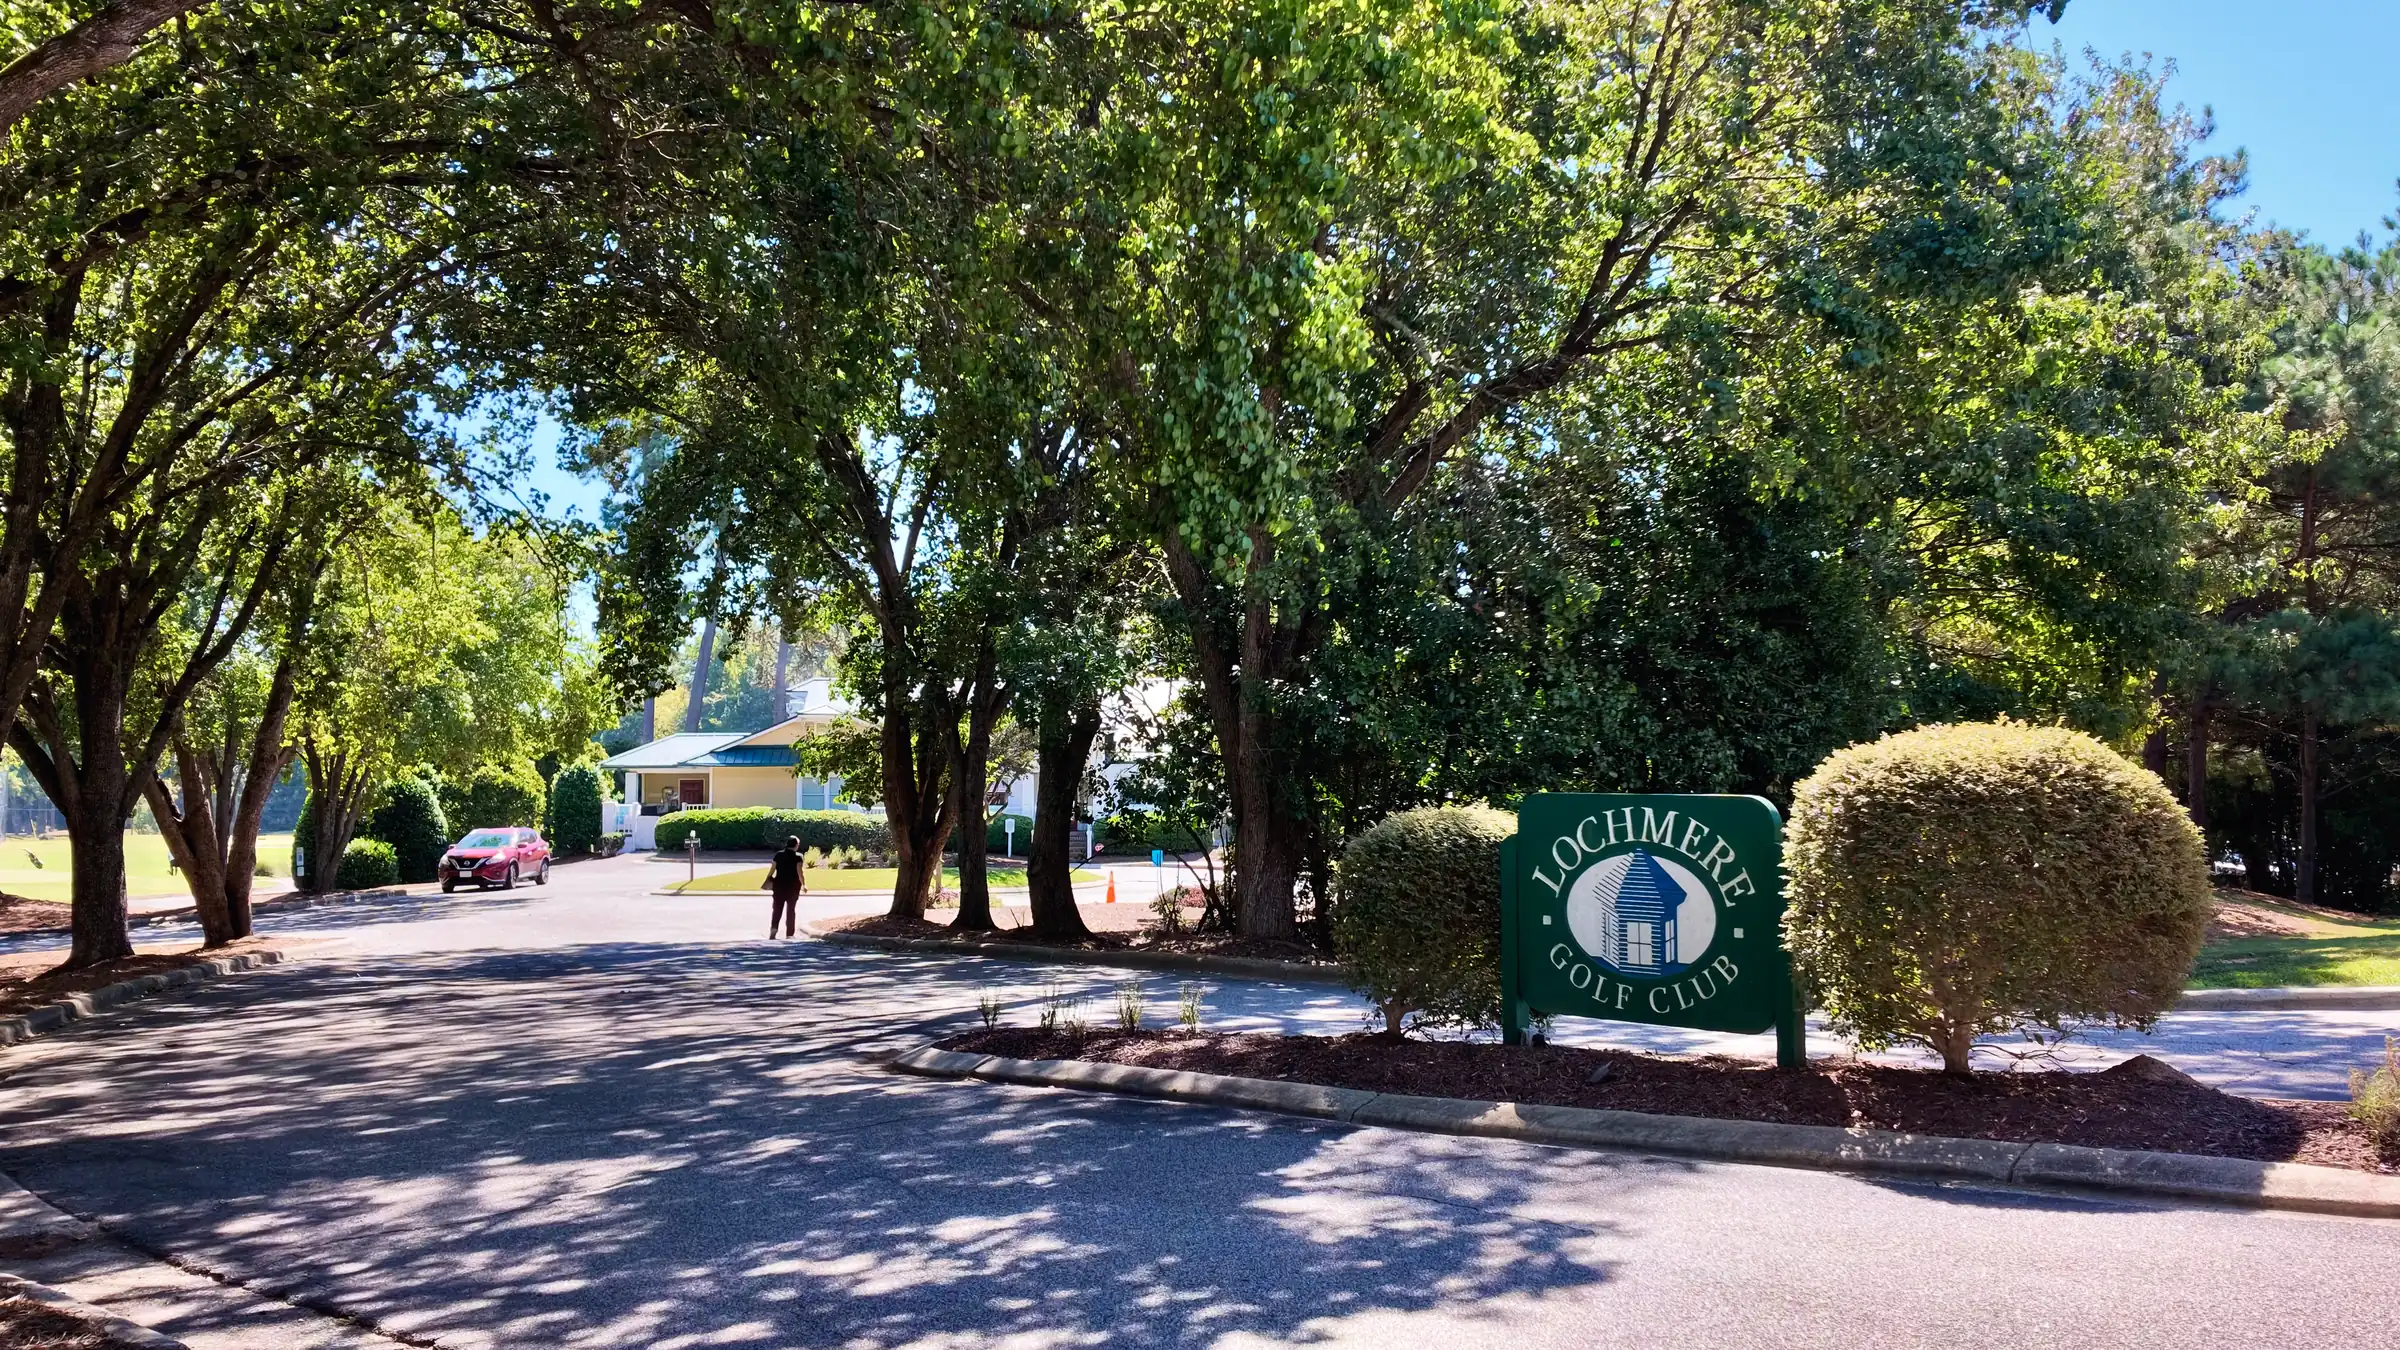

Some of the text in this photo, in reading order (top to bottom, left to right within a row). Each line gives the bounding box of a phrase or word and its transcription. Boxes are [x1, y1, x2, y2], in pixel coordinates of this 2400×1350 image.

[1532, 806, 1755, 907] LOCHMERE
[1550, 943, 1738, 1013] GOLF CLUB
